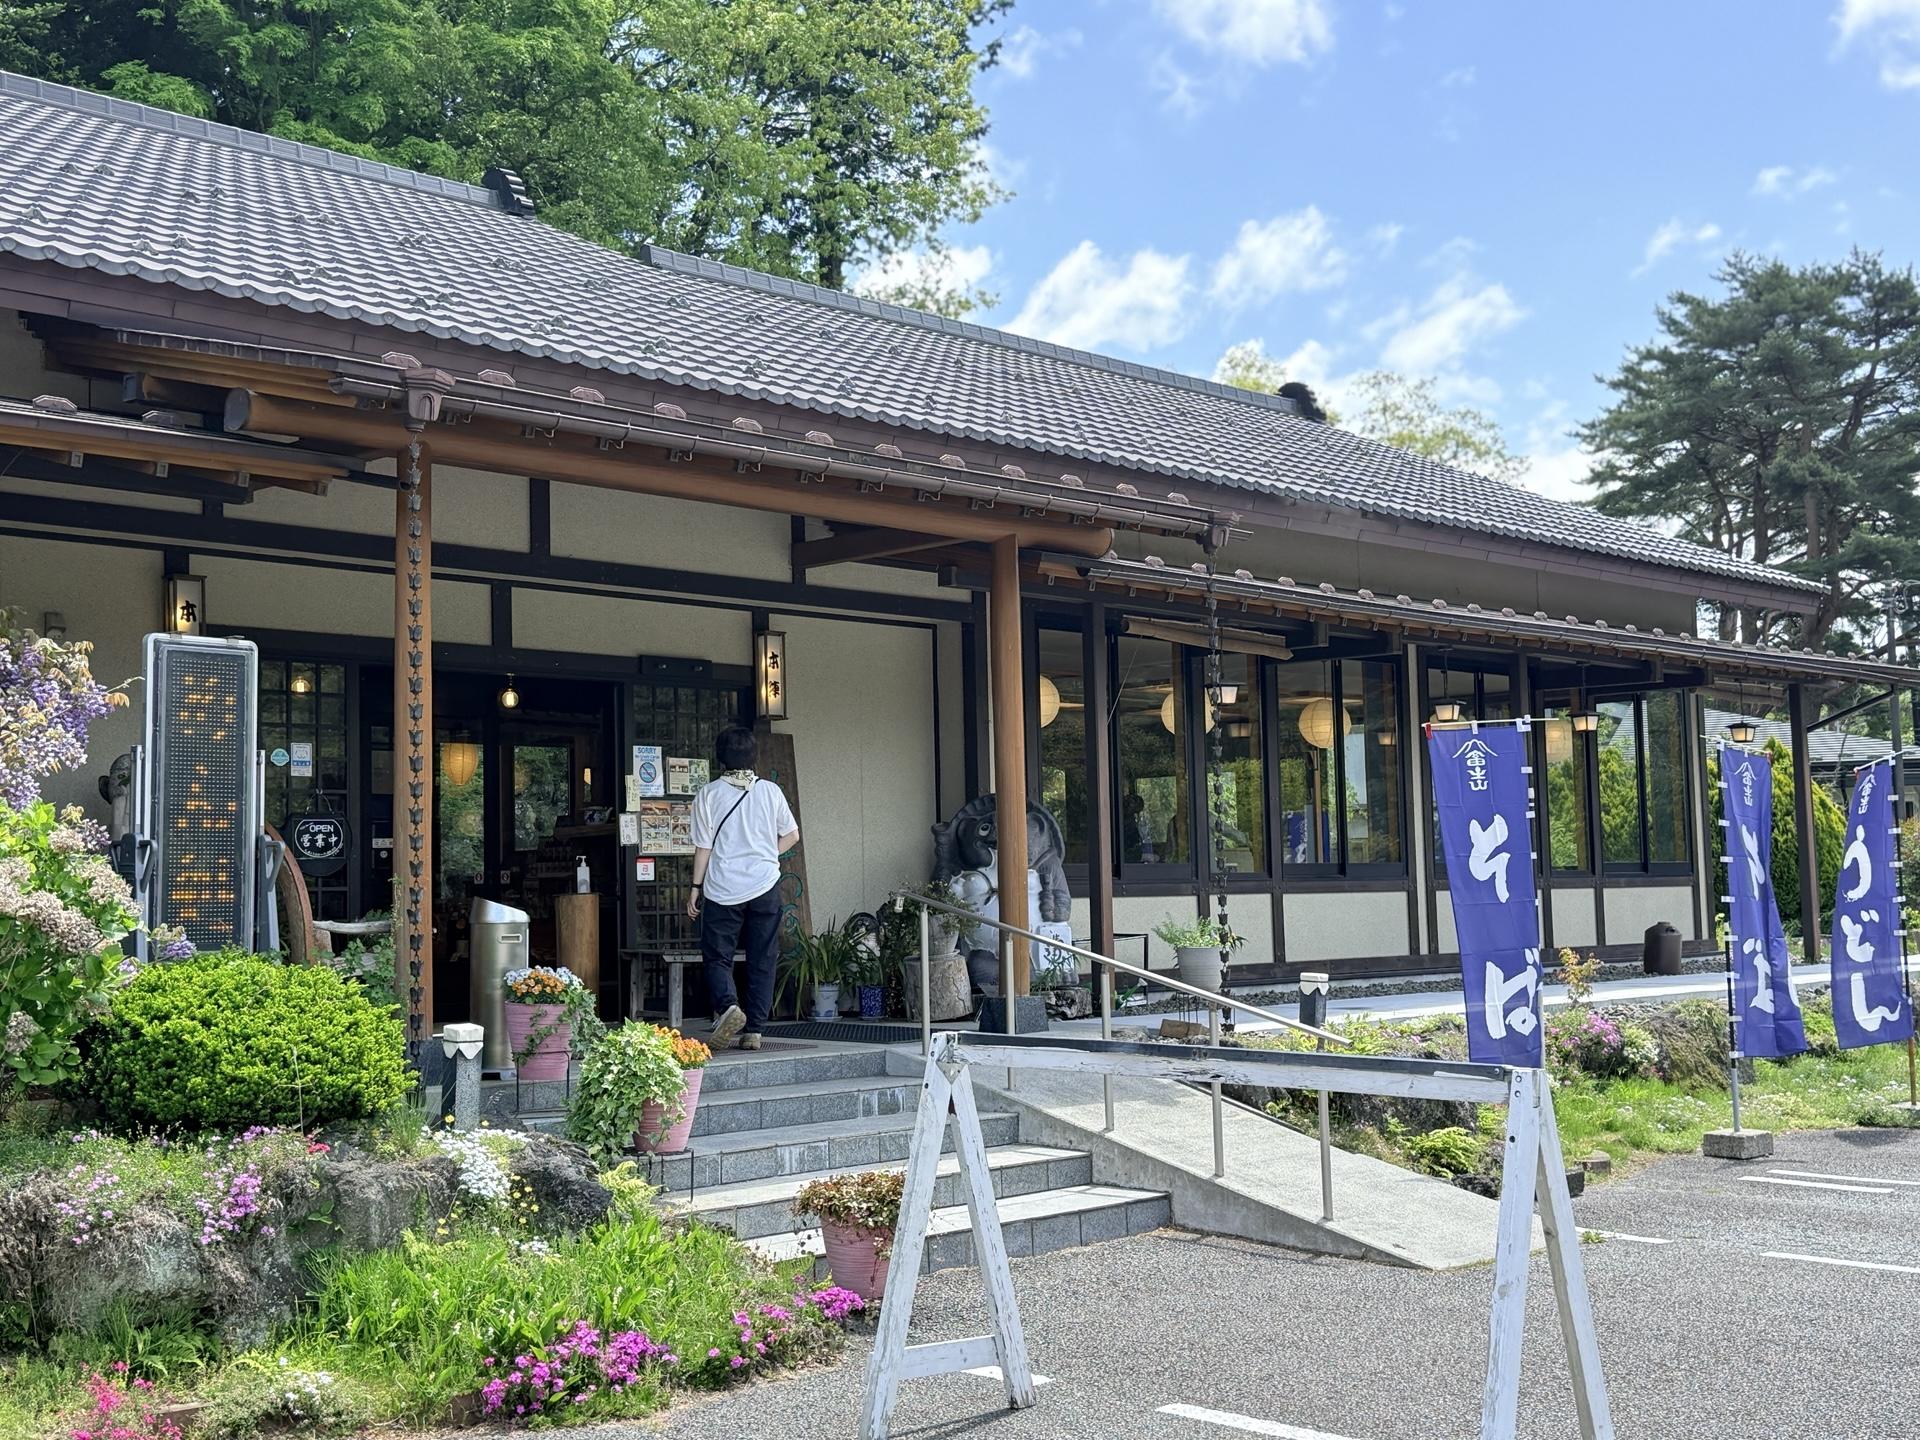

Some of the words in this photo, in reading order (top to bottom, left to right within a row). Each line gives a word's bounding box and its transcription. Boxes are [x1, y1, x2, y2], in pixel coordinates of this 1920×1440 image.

[179, 599, 197, 623] 本
[300, 833, 339, 848] 営業中
[309, 824, 334, 833] OPEN
[1468, 814, 1541, 1040] そば
[1841, 824, 1900, 1032] うどん
